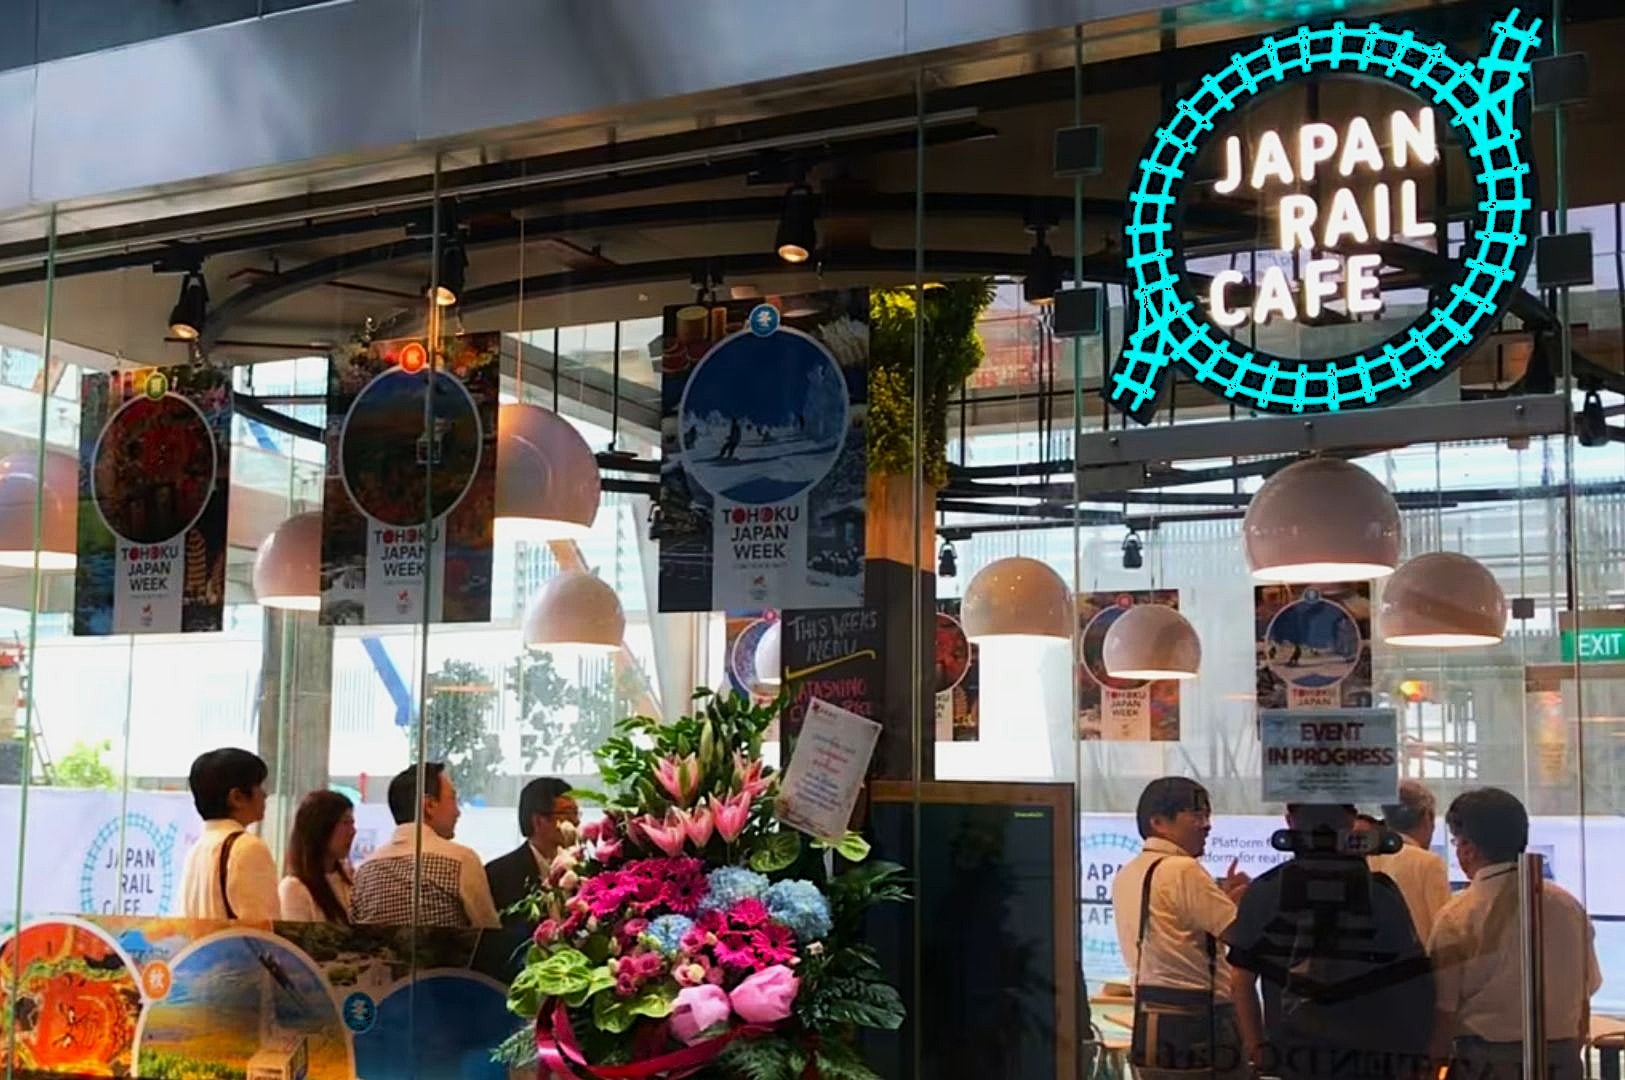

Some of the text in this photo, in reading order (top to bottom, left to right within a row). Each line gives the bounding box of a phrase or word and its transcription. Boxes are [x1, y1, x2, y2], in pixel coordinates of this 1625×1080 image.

[1213, 106, 1436, 194] JAPAN
[1279, 179, 1437, 252] RAIL
[1209, 253, 1383, 327] CAFE
[722, 505, 800, 525] TOHOKU
[731, 524, 789, 542] JAPAN
[121, 544, 180, 562] TOHOKU
[733, 543, 786, 560] WEEK
[128, 561, 172, 577] JAPAN
[129, 577, 169, 593] WEEK
[787, 615, 828, 641] THIS
[1578, 633, 1623, 656] EXIT
[1301, 722, 1365, 742] EVENT
[1267, 746, 1396, 767] IN PROGRESS
[1211, 835, 1264, 849] Platform
